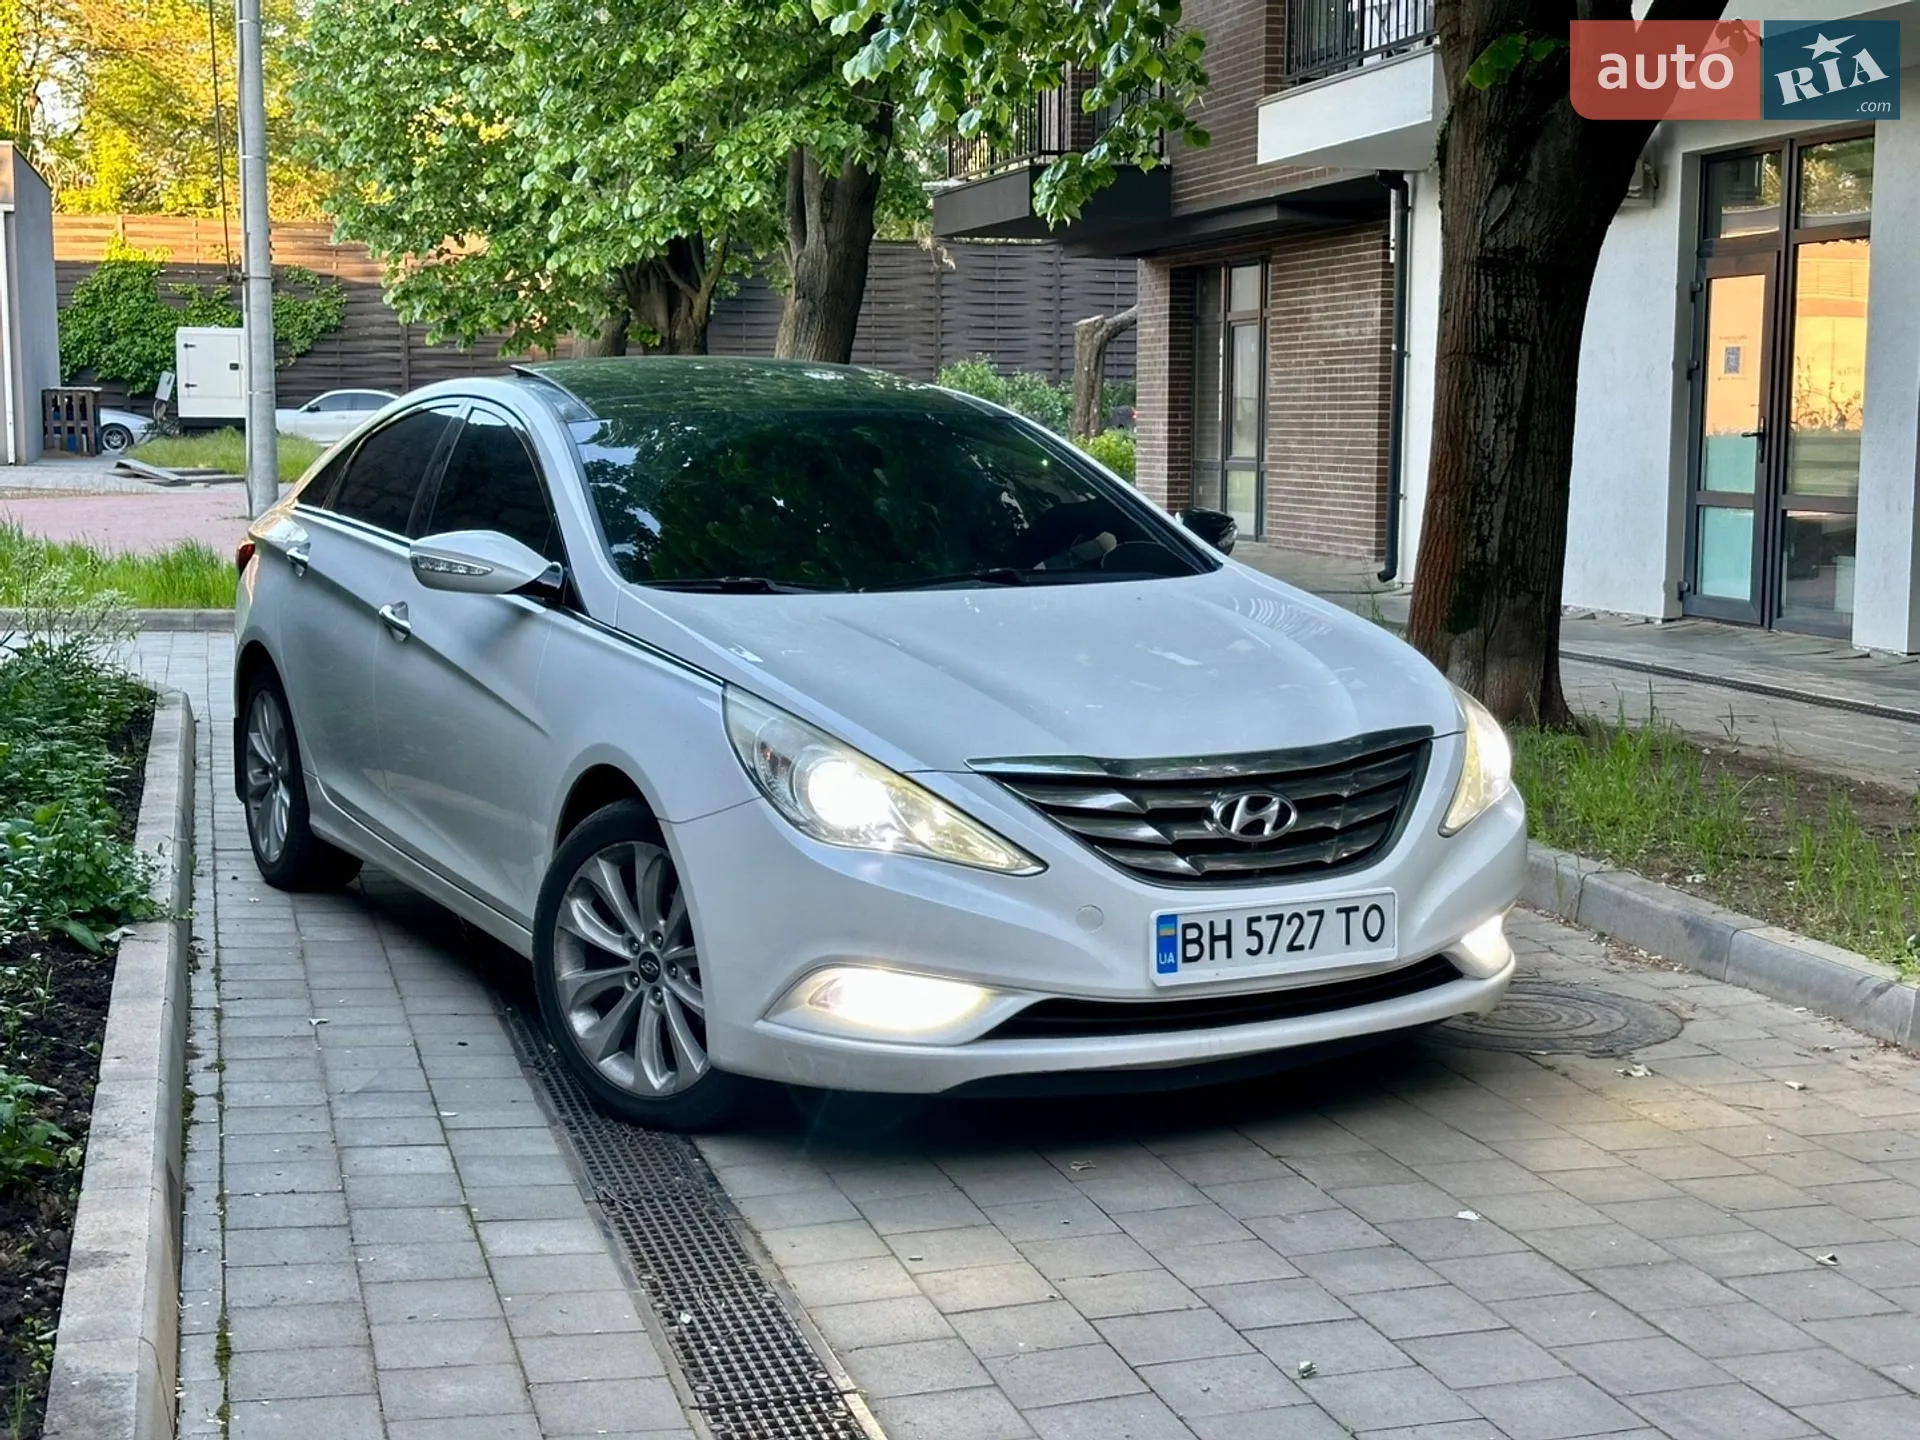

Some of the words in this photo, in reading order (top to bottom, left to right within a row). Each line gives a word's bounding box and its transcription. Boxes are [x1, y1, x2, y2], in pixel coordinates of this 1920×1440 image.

[1181, 918, 1233, 964] BH
[1245, 908, 1325, 957] 5727
[1336, 903, 1386, 946] TO
[1158, 951, 1176, 965] UA
